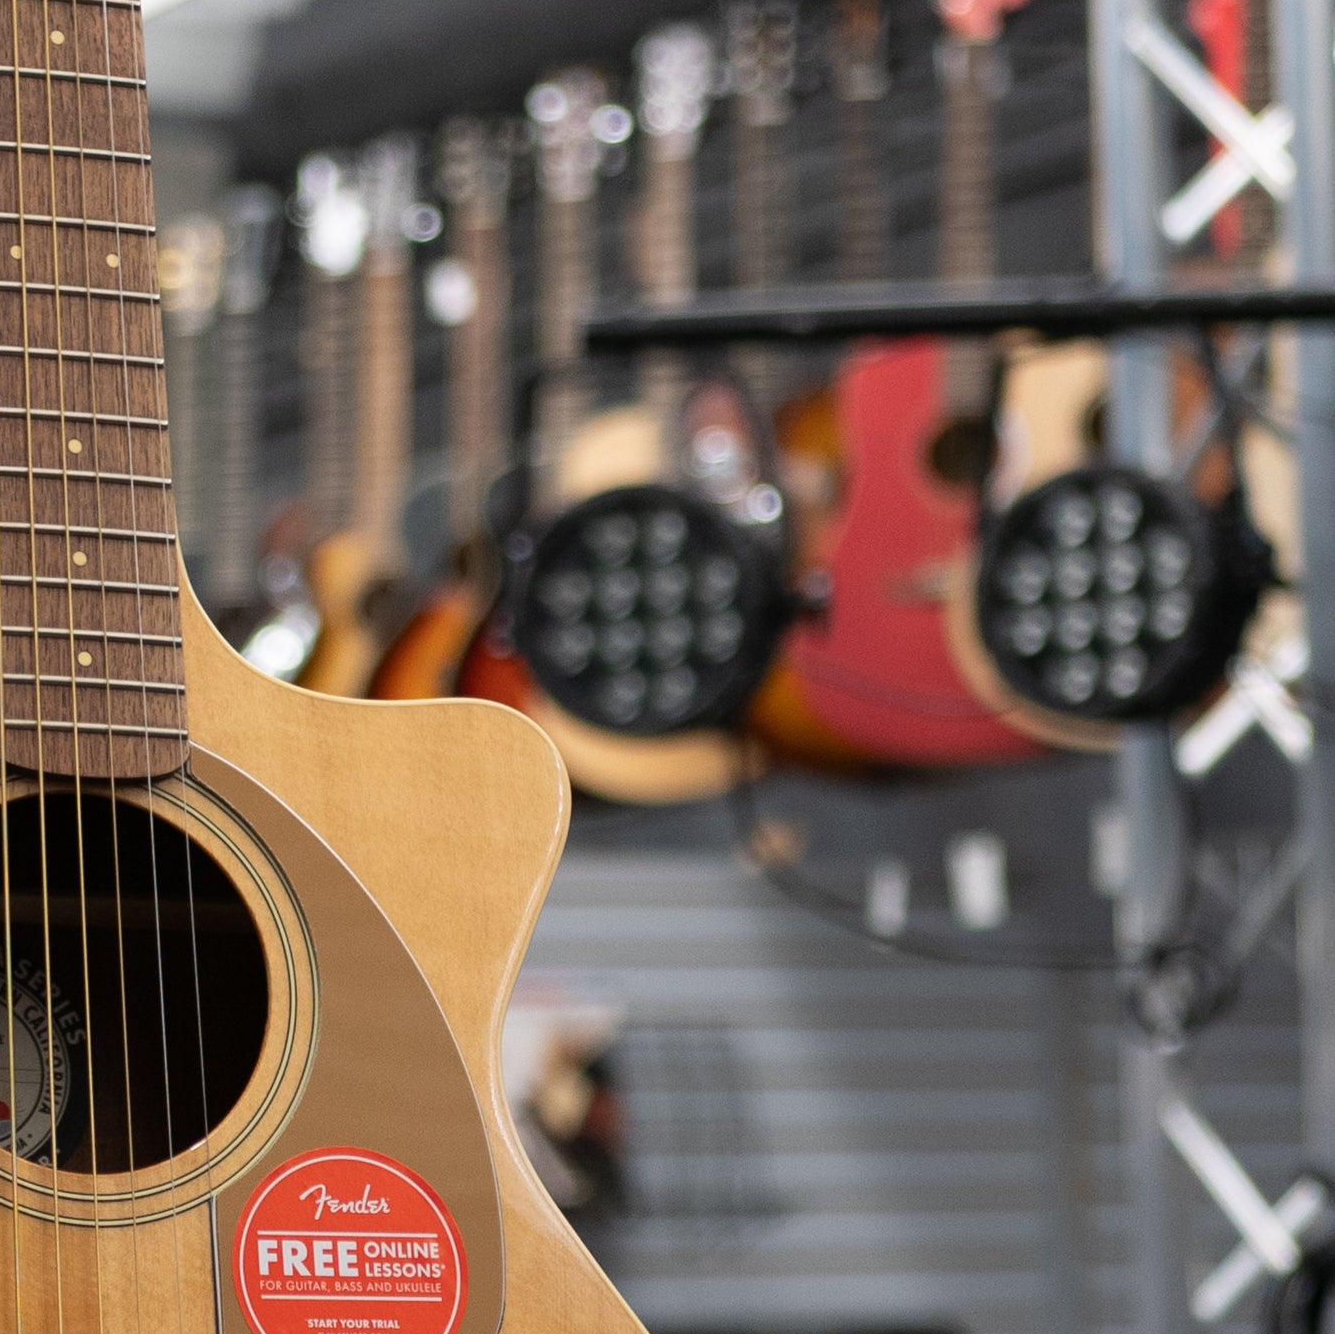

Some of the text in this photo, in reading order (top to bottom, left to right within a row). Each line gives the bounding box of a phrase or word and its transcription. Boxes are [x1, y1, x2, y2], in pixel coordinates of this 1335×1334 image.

[299, 1184, 390, 1220] Fender
[257, 1239, 359, 1277] FREE
[364, 1241, 440, 1259] ONLINE
[259, 1280, 442, 1294] FOR GUITAR, BASS AND UKULELE
[340, 1319, 370, 1329] YOUR
[371, 1319, 400, 1330] TRIAL
